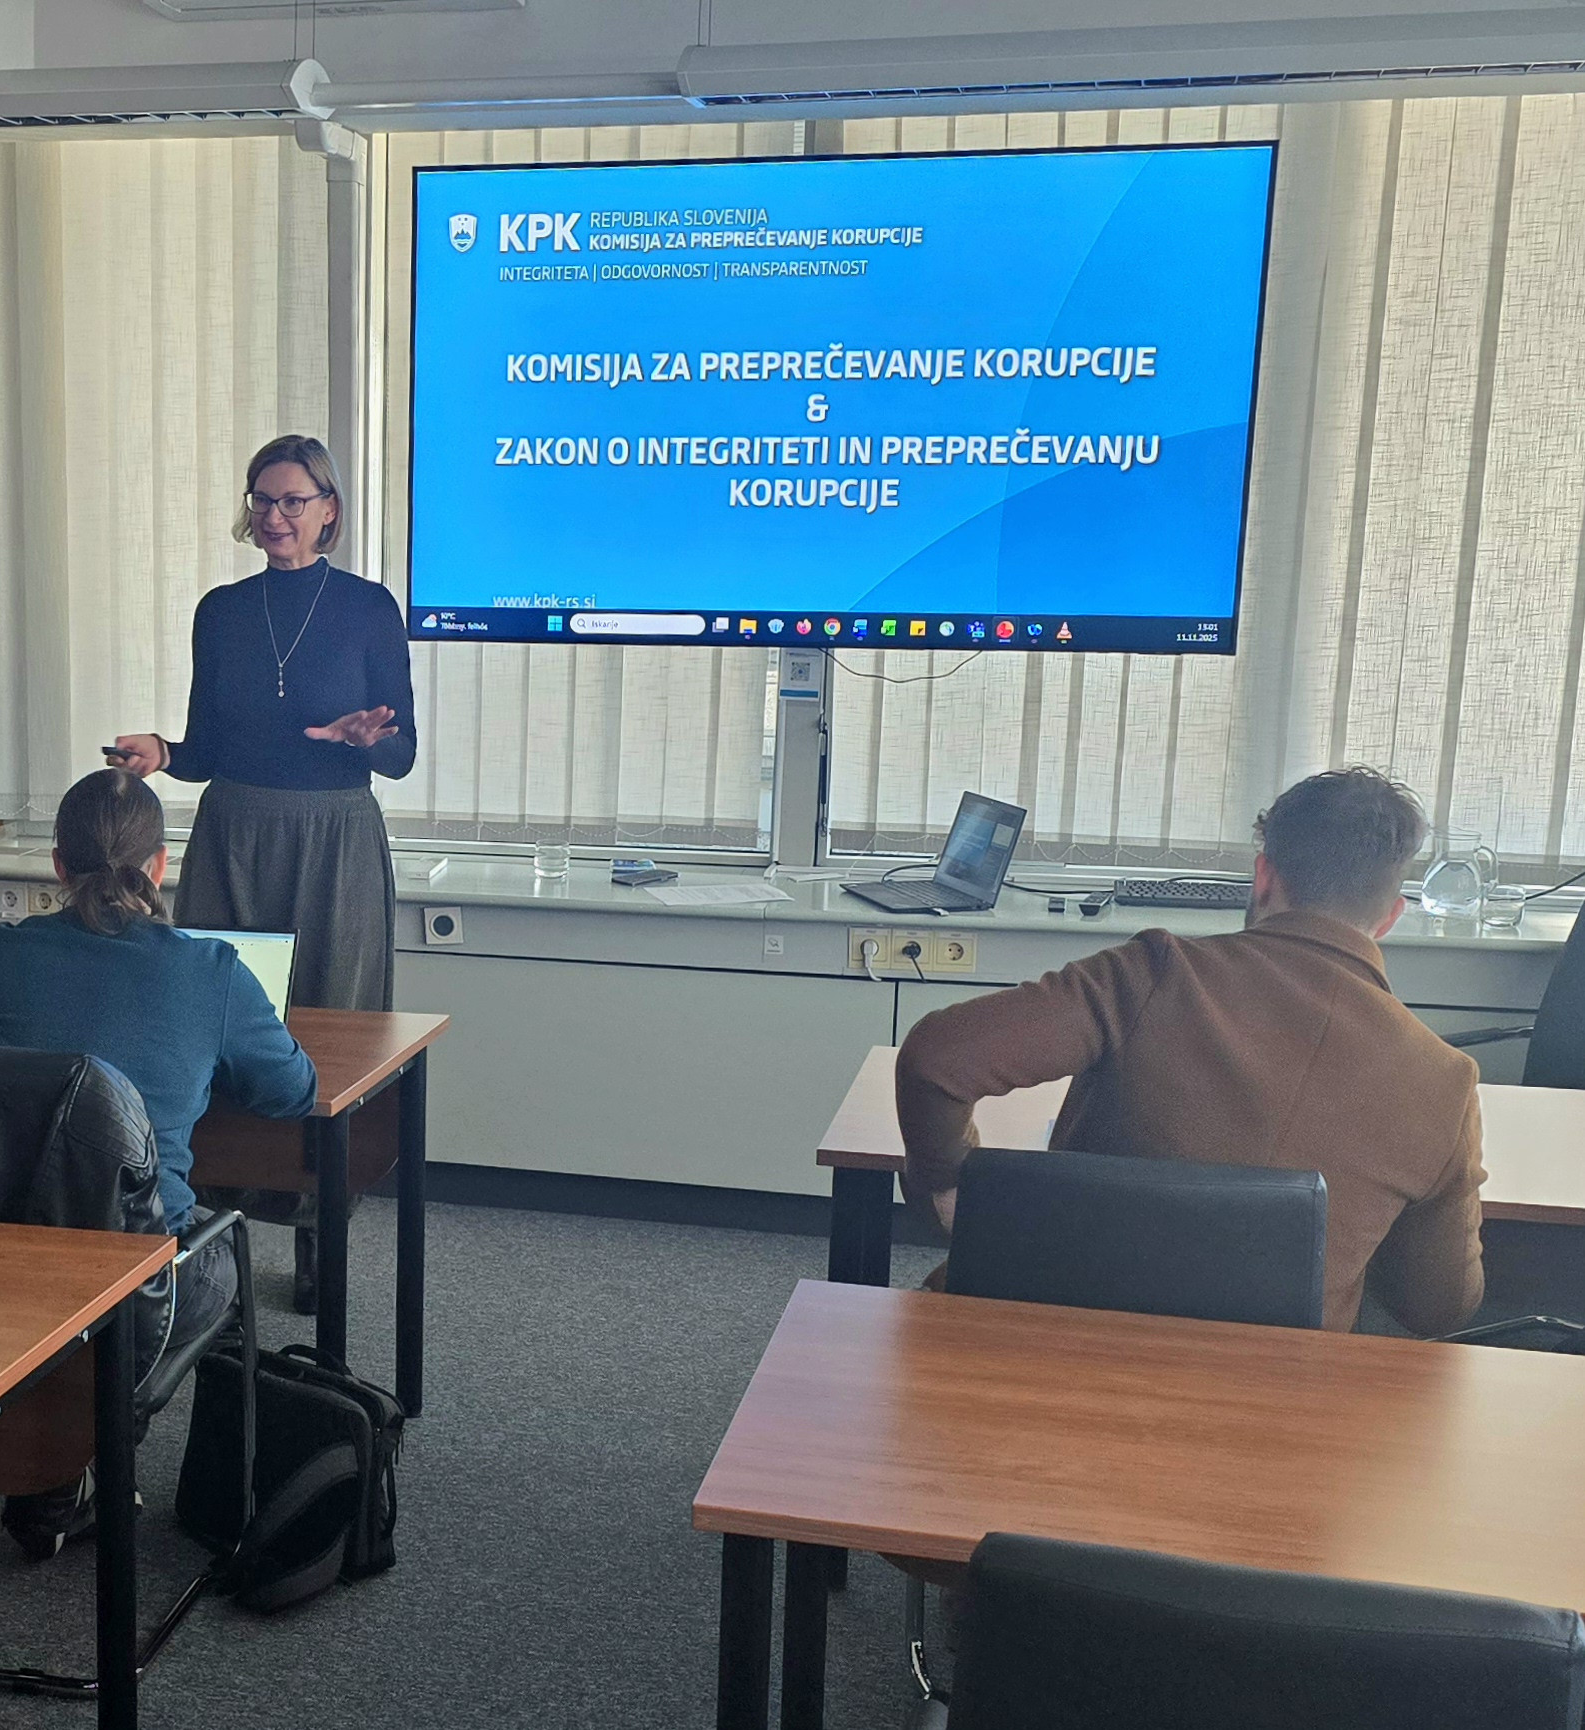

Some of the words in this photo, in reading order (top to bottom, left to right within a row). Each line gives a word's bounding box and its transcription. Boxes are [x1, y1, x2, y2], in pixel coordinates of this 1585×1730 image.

[590, 210, 679, 228] REPUBLIKA
[684, 208, 768, 227] SLOVENIJA
[499, 212, 582, 252] KPK
[589, 232, 661, 252] KOMISIJA
[665, 232, 687, 249] ZA
[690, 227, 827, 249] PREPREČEVANJE
[831, 227, 923, 247] KORUPCIJE
[499, 265, 589, 281] INTEGRITETA
[601, 263, 709, 279] ODGOVORNOST
[722, 260, 868, 277] TRANSPARENTNOST
[506, 353, 644, 388] KOMISIJA
[651, 352, 691, 381] ZA
[699, 342, 965, 385] PREPREČEVANJE
[973, 347, 1157, 384] KORUPCIJE
[806, 394, 829, 422] &
[495, 437, 599, 465] ZAKON
[607, 437, 629, 465] O
[638, 437, 829, 465] INTEGRITETI
[838, 436, 871, 465] IN
[881, 427, 1160, 471] PREPREČEVANJU
[729, 479, 900, 514] KORUPCIJE
[492, 593, 596, 608] www.kpk-rs.si
[1176, 633, 1218, 641] 11.11.2025
